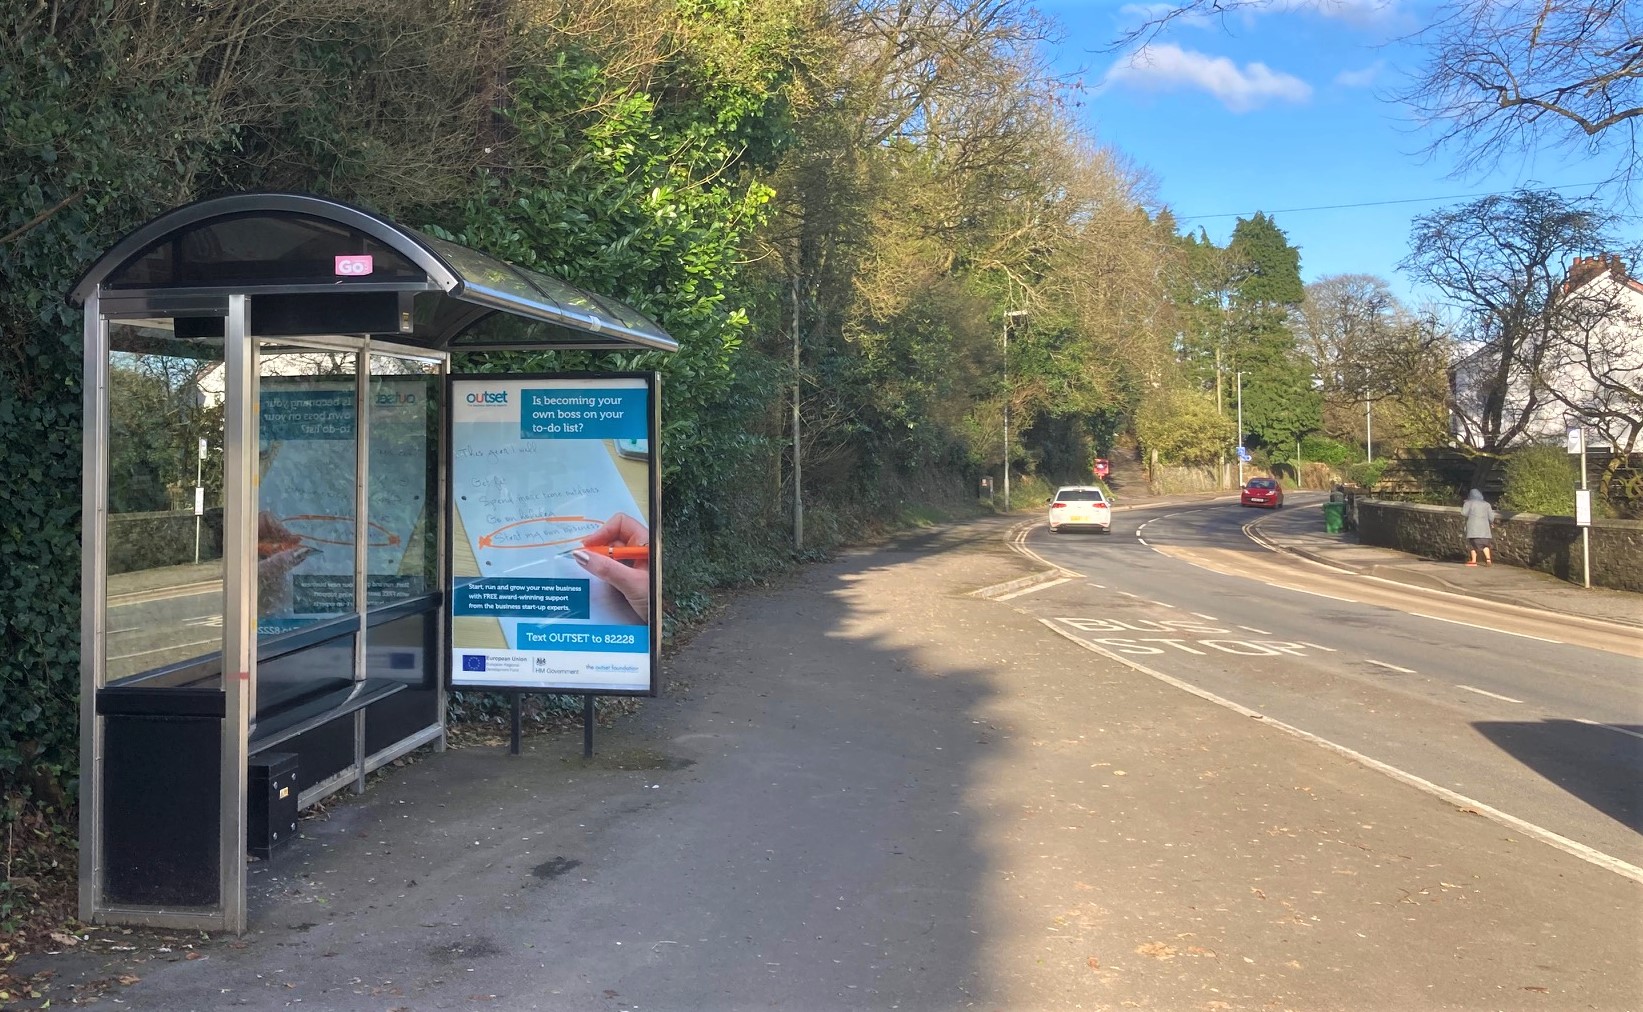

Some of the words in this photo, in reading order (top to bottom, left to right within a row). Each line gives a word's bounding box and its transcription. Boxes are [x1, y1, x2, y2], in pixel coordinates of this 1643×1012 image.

[466, 391, 508, 403] outset
[532, 396, 541, 405] Is
[544, 396, 595, 407] becoming
[598, 397, 622, 407] your
[532, 411, 555, 419] own
[557, 410, 581, 419] boss
[583, 411, 597, 419] on
[599, 411, 624, 421] your
[532, 423, 561, 432] to-do
[563, 423, 584, 432] list?
[1054, 617, 1232, 634] BUS
[526, 632, 546, 642] Text
[549, 633, 590, 643] OUTSET
[592, 634, 602, 643] to
[604, 634, 635, 644] 82228
[1093, 638, 1309, 656] STOP
